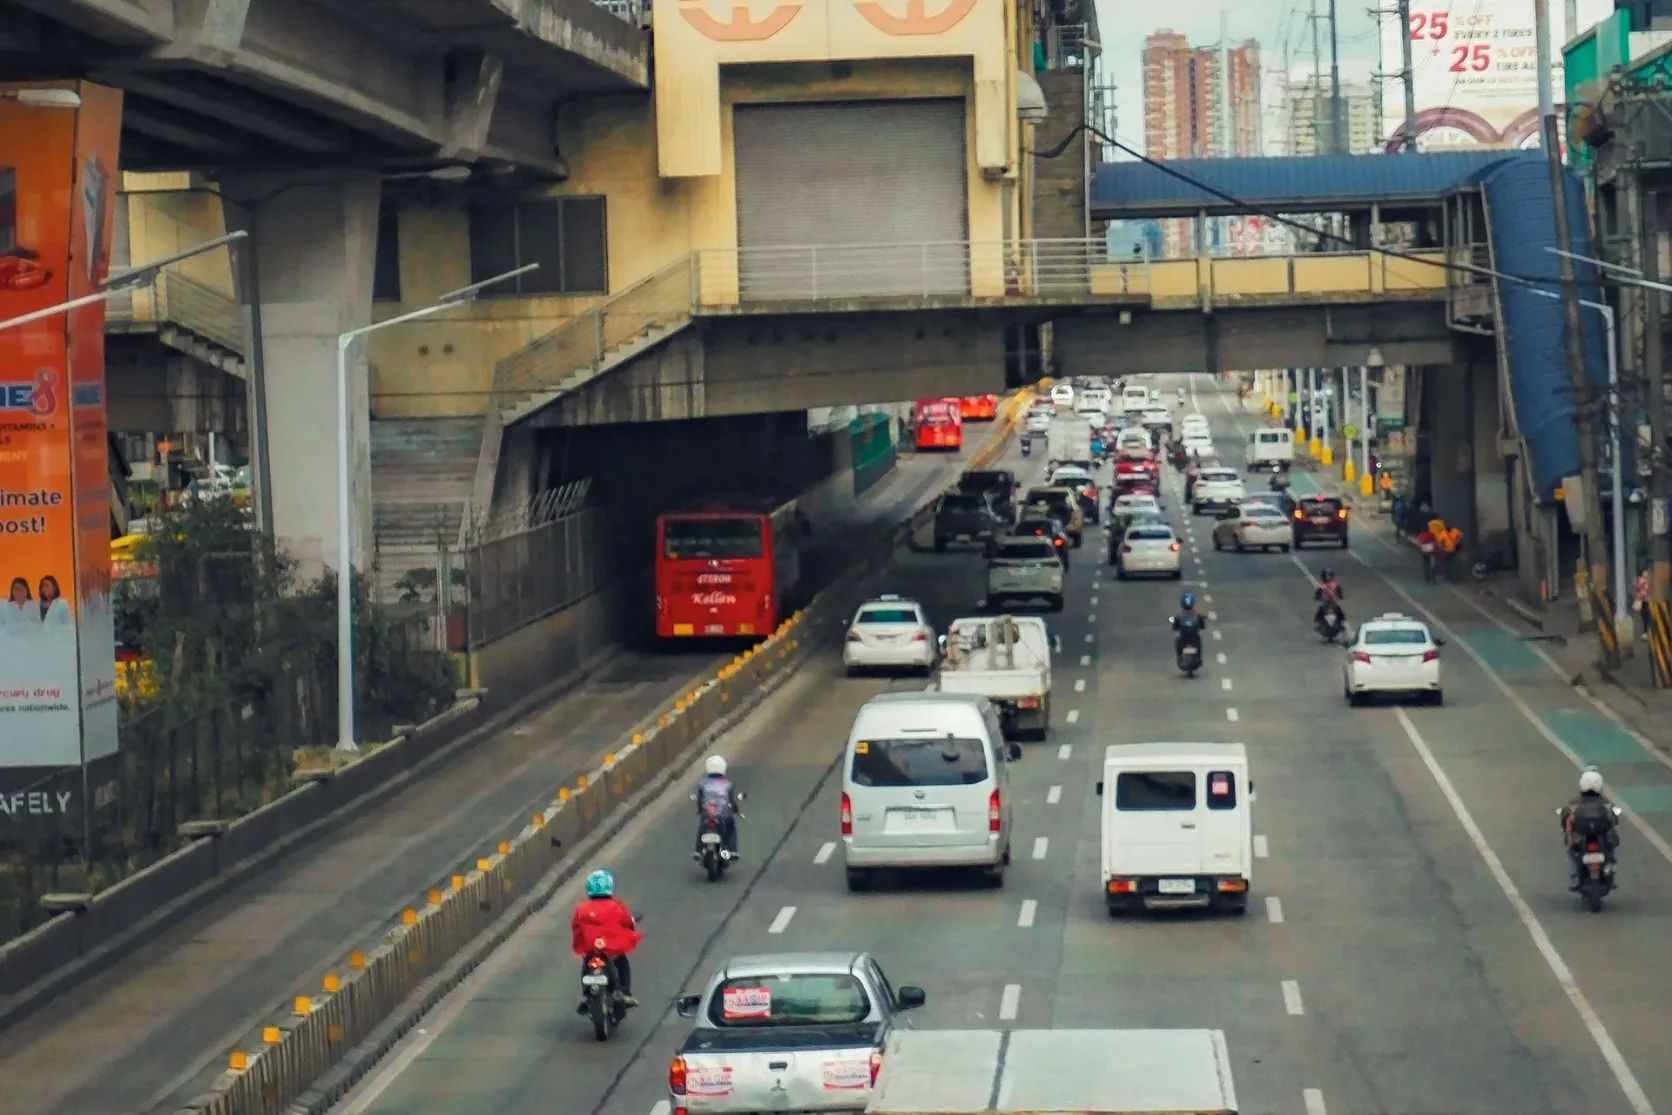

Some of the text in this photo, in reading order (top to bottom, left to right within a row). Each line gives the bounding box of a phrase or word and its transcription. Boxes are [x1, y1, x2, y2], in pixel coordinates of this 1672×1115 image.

[1408, 11, 1449, 40] 25
[1502, 28, 1533, 38] TIRES
[1449, 44, 1491, 72] 25
